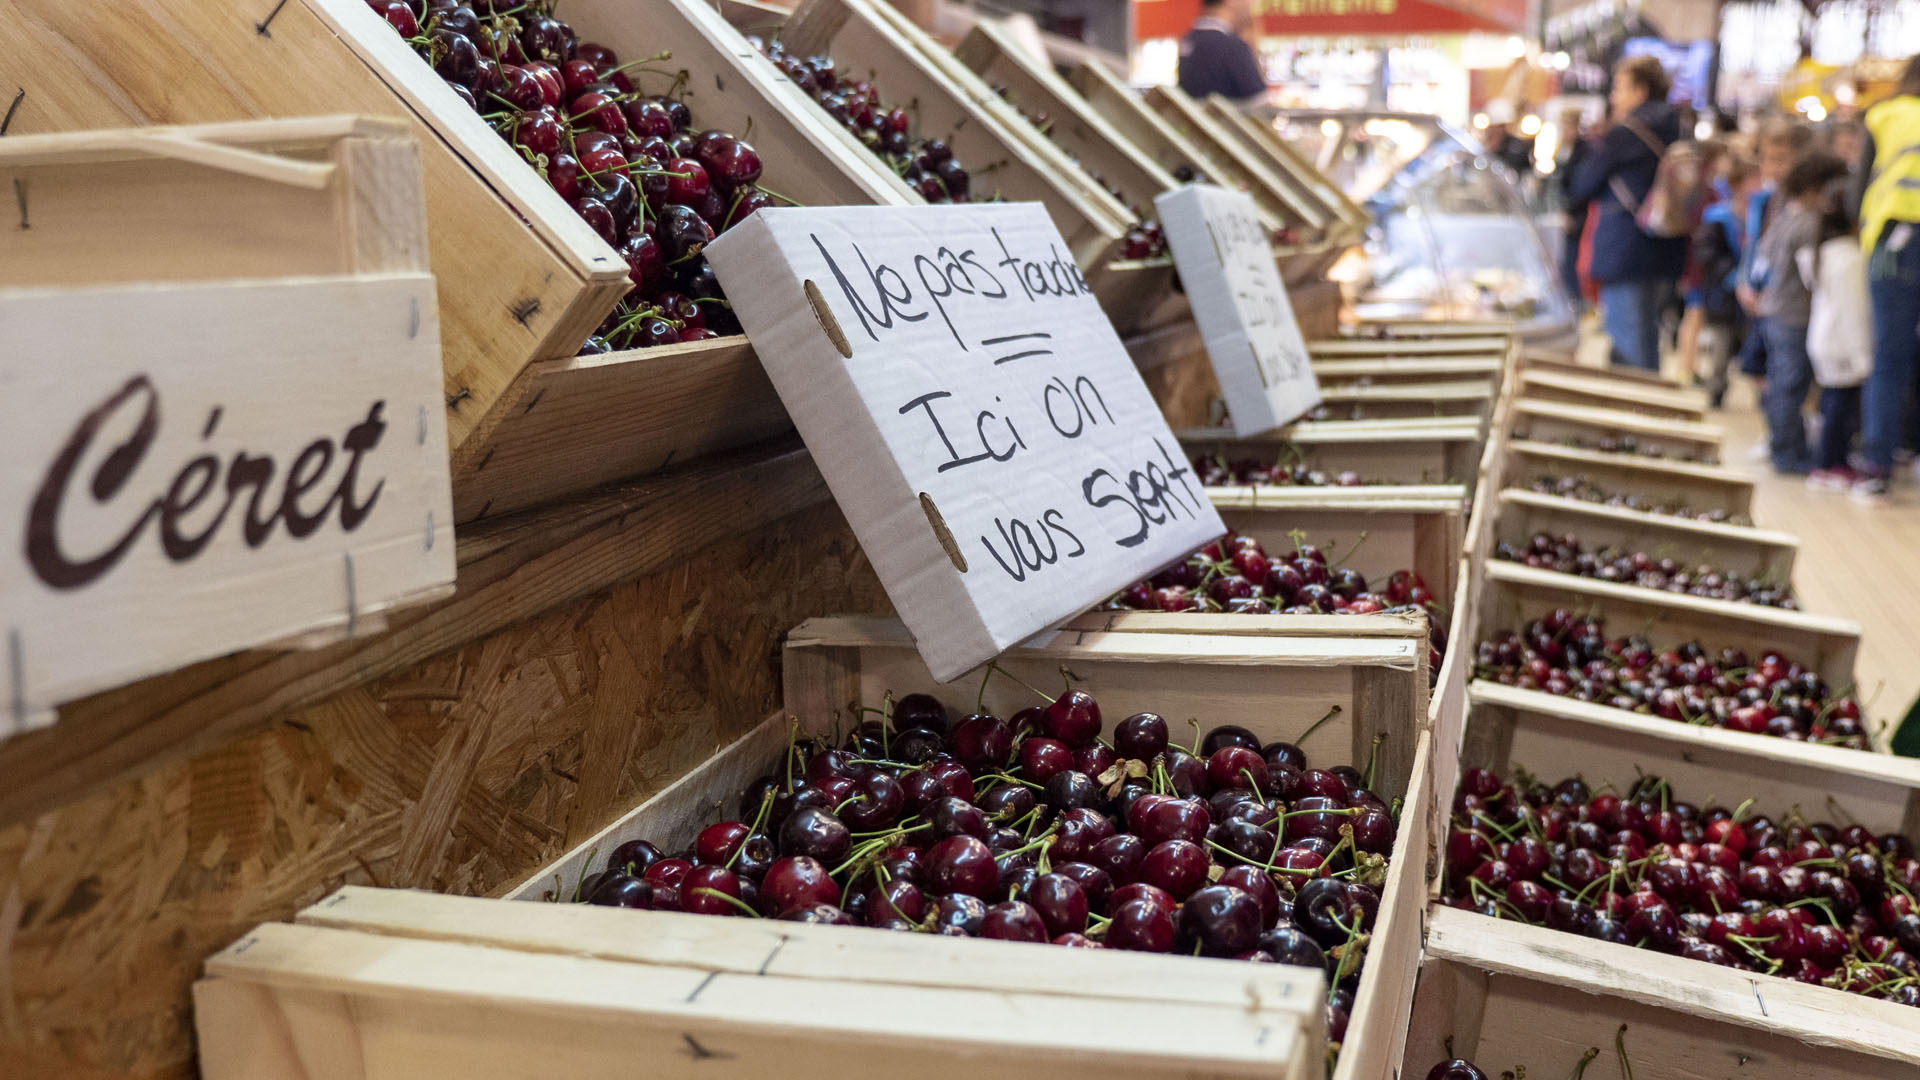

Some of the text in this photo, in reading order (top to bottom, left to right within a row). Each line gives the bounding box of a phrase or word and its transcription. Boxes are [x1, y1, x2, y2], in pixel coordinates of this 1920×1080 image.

[810, 233, 929, 341] Ne
[914, 246, 1006, 352] pas
[23, 373, 388, 590] Céret
[899, 391, 1027, 473] Ici
[981, 509, 1085, 582] vous
